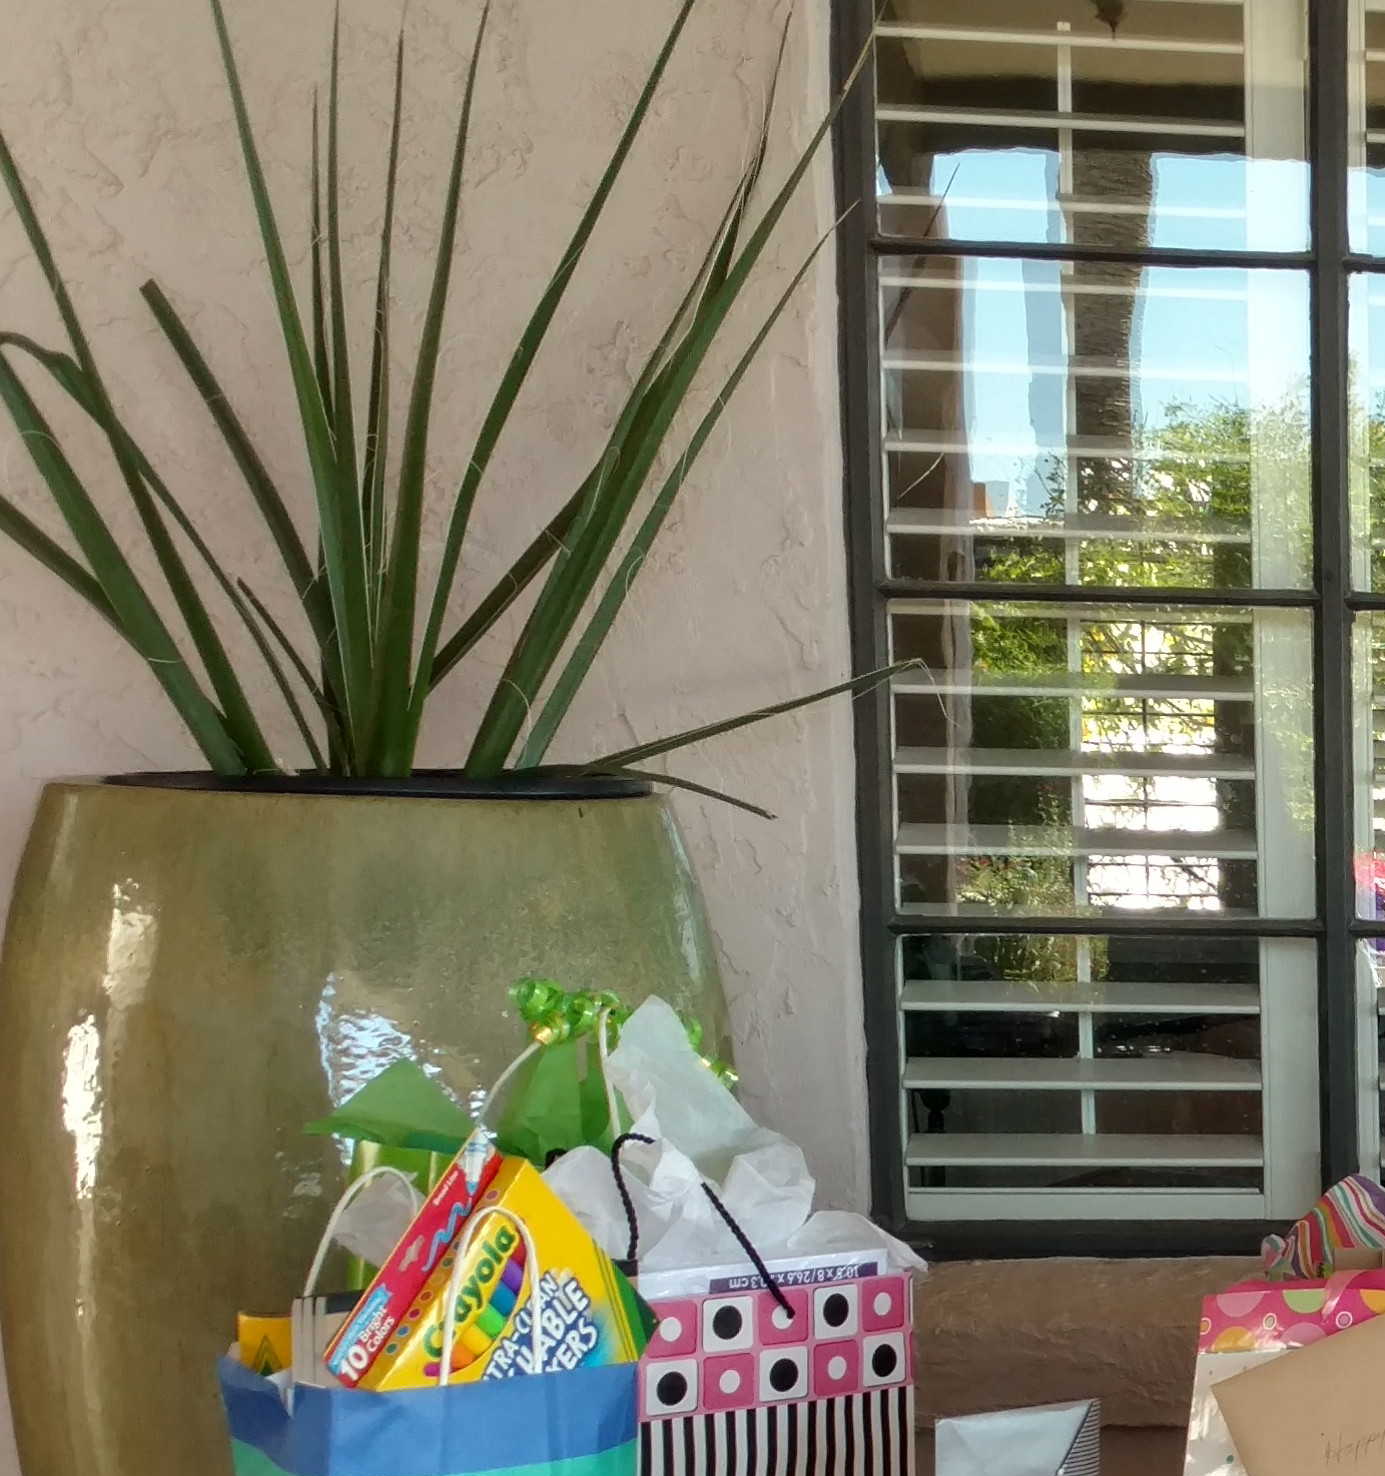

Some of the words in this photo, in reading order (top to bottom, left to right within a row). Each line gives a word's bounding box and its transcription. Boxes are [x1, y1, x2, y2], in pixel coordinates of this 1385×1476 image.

[357, 1307, 388, 1344] Bright
[366, 1315, 396, 1353] Colors
[339, 1345, 370, 1381] 10
